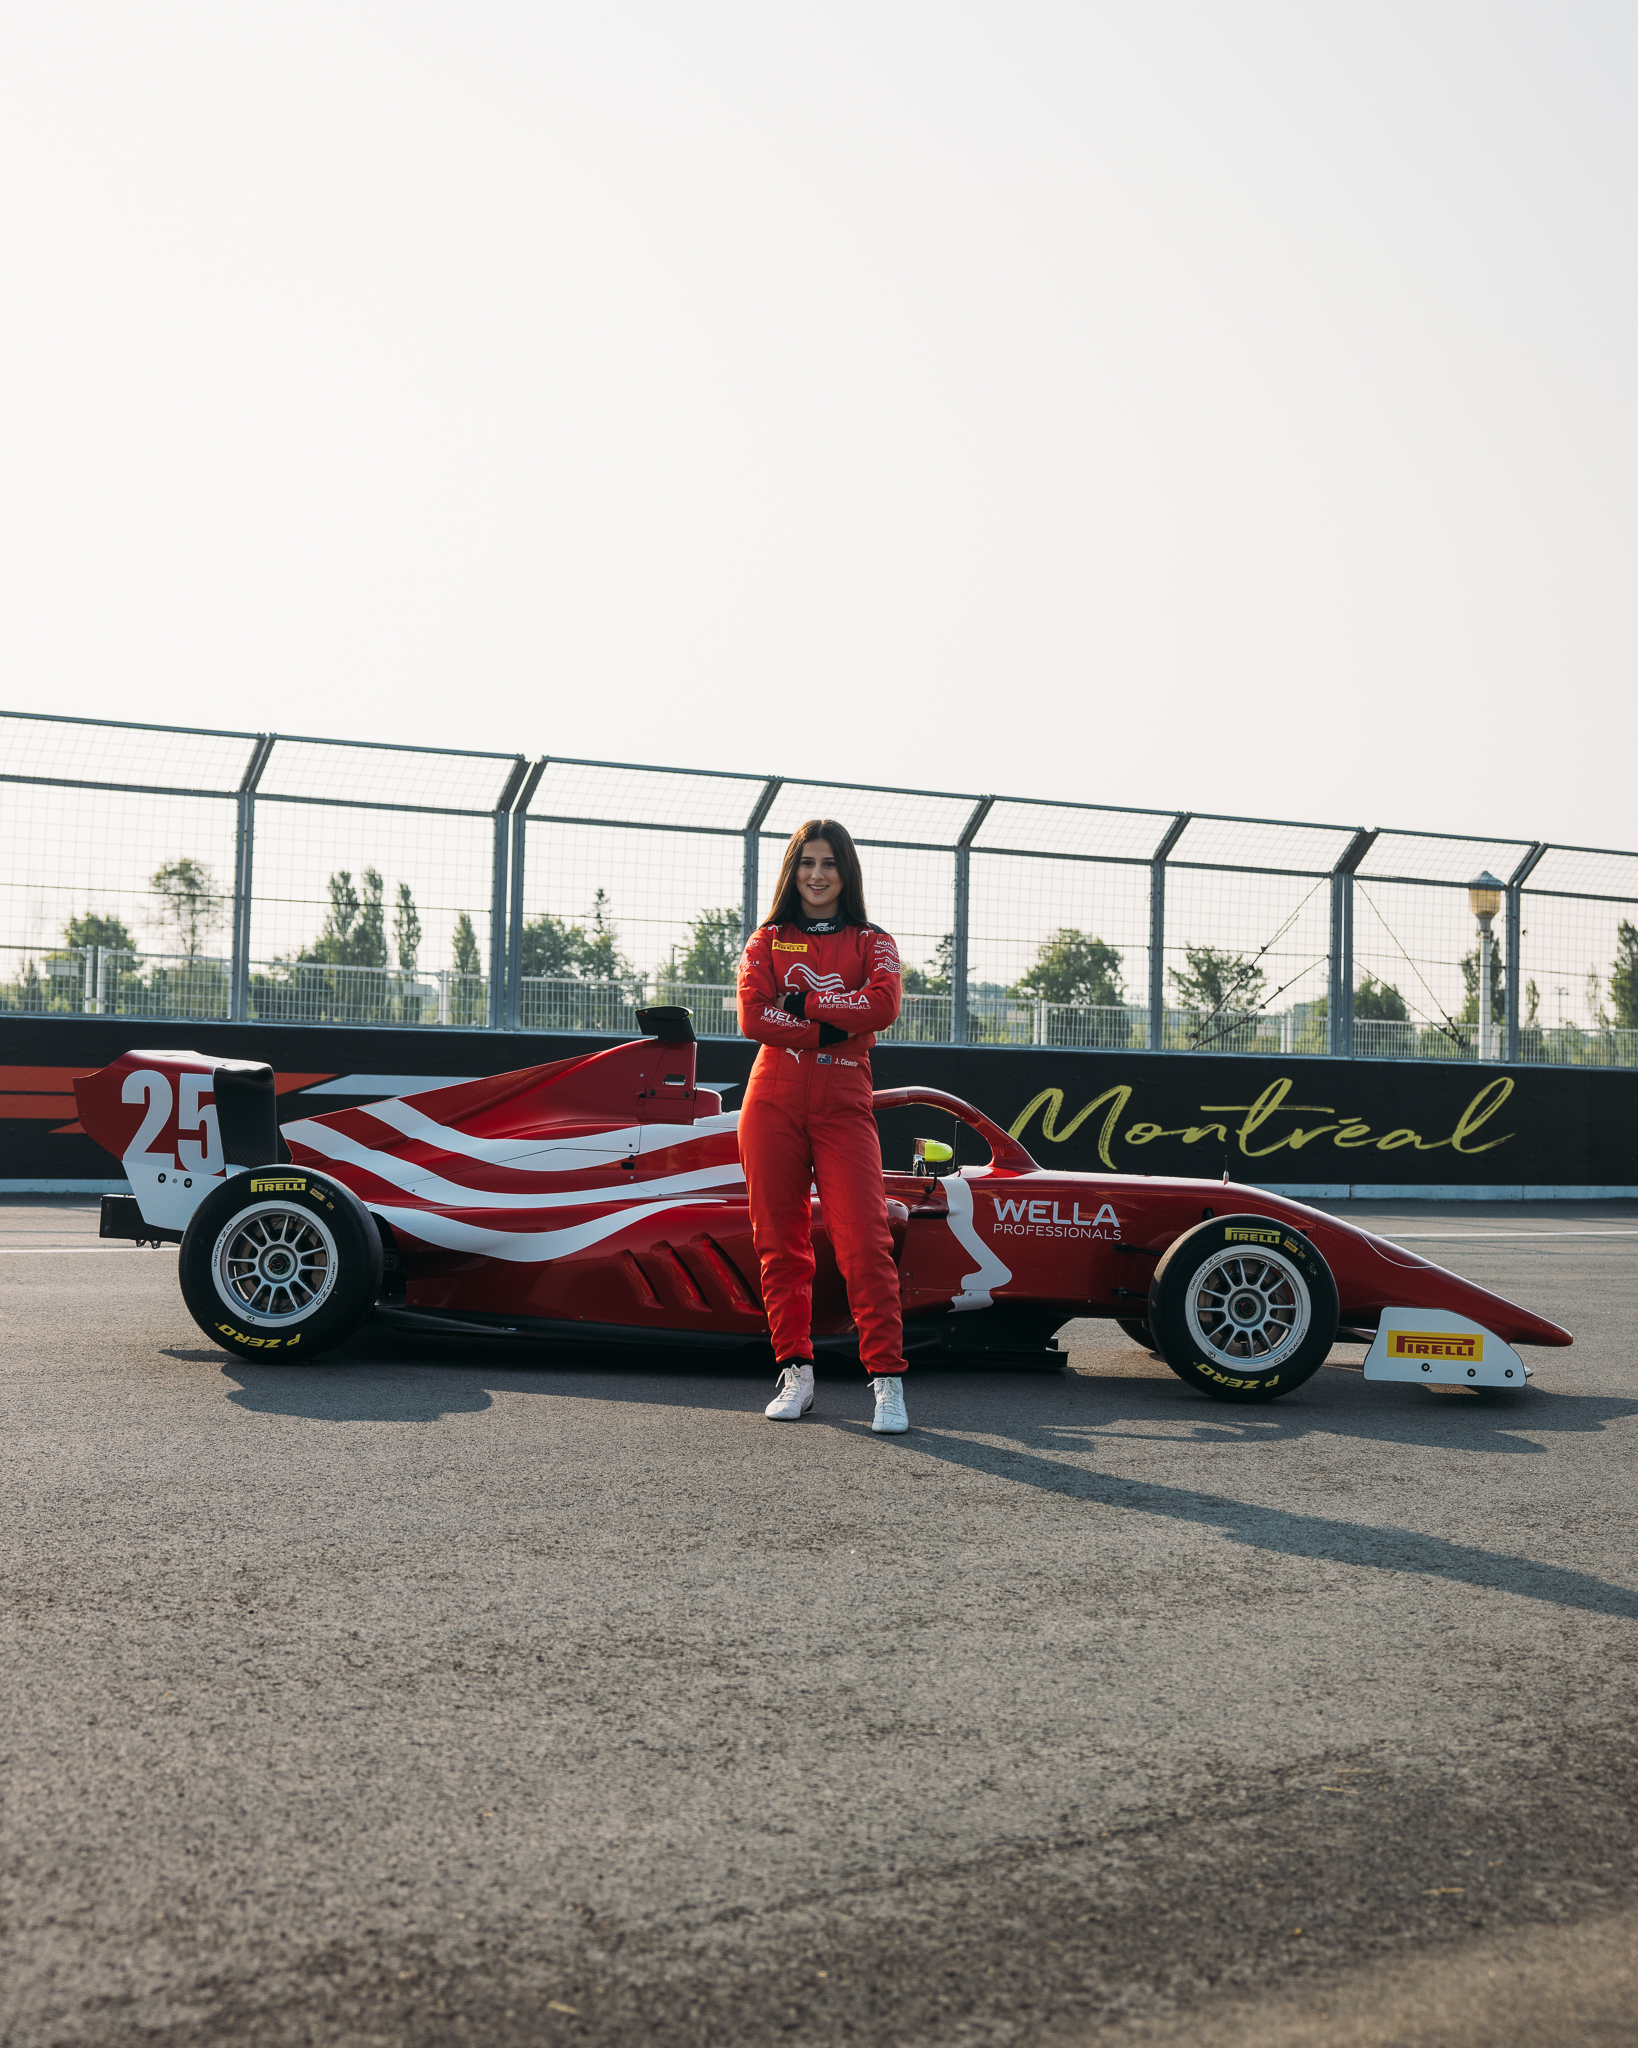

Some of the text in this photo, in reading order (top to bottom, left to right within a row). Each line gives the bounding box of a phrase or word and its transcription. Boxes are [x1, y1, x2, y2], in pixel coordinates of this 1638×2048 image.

[818, 995, 869, 1006] WELLA
[834, 1057, 840, 1065] J.
[121, 1069, 226, 1175] 25
[1008, 1077, 1516, 1170] Montréal
[250, 1177, 307, 1193] PIRELLI
[993, 1198, 1120, 1227] WELLA
[993, 1223, 1122, 1240] PROFESSIONALS
[1224, 1227, 1281, 1244] PIRELLI
[213, 1239, 223, 1267] RACING
[326, 1262, 336, 1291] RACING
[1190, 1265, 1207, 1291] RACING
[218, 1324, 301, 1348] P ZERO
[1288, 1328, 1306, 1353] RACING
[1396, 1335, 1475, 1356] PIRELLI
[1196, 1363, 1280, 1389] P ZERO
